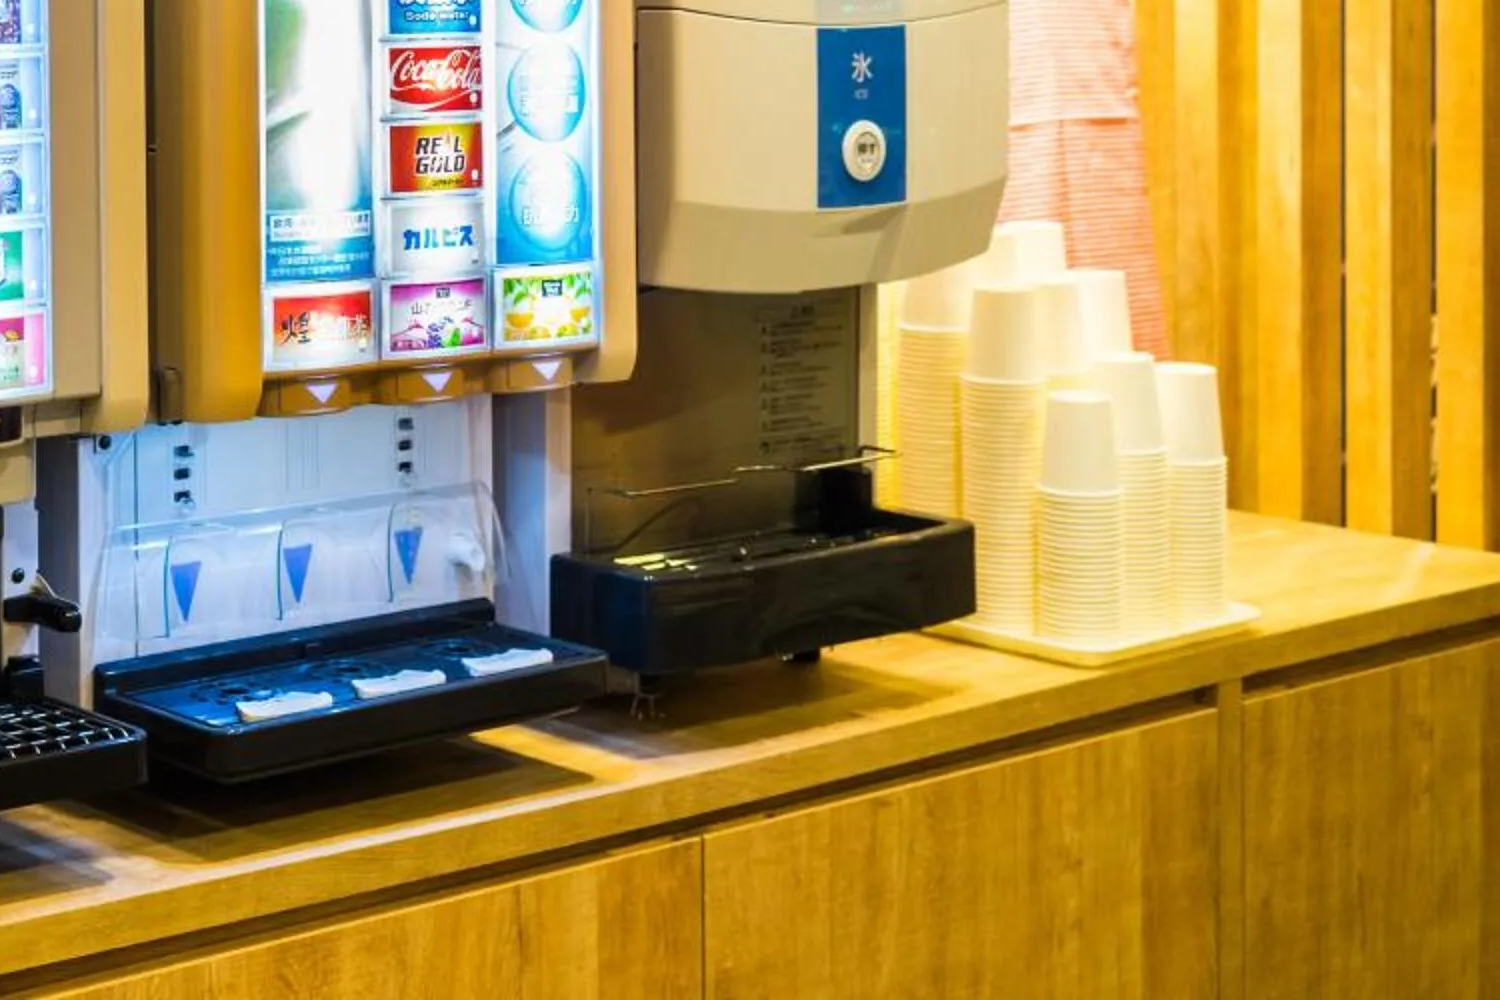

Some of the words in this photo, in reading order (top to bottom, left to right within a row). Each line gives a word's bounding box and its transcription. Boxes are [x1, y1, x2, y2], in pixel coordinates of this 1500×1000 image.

[851, 51, 874, 83] 氷
[403, 224, 474, 251] カルピス
